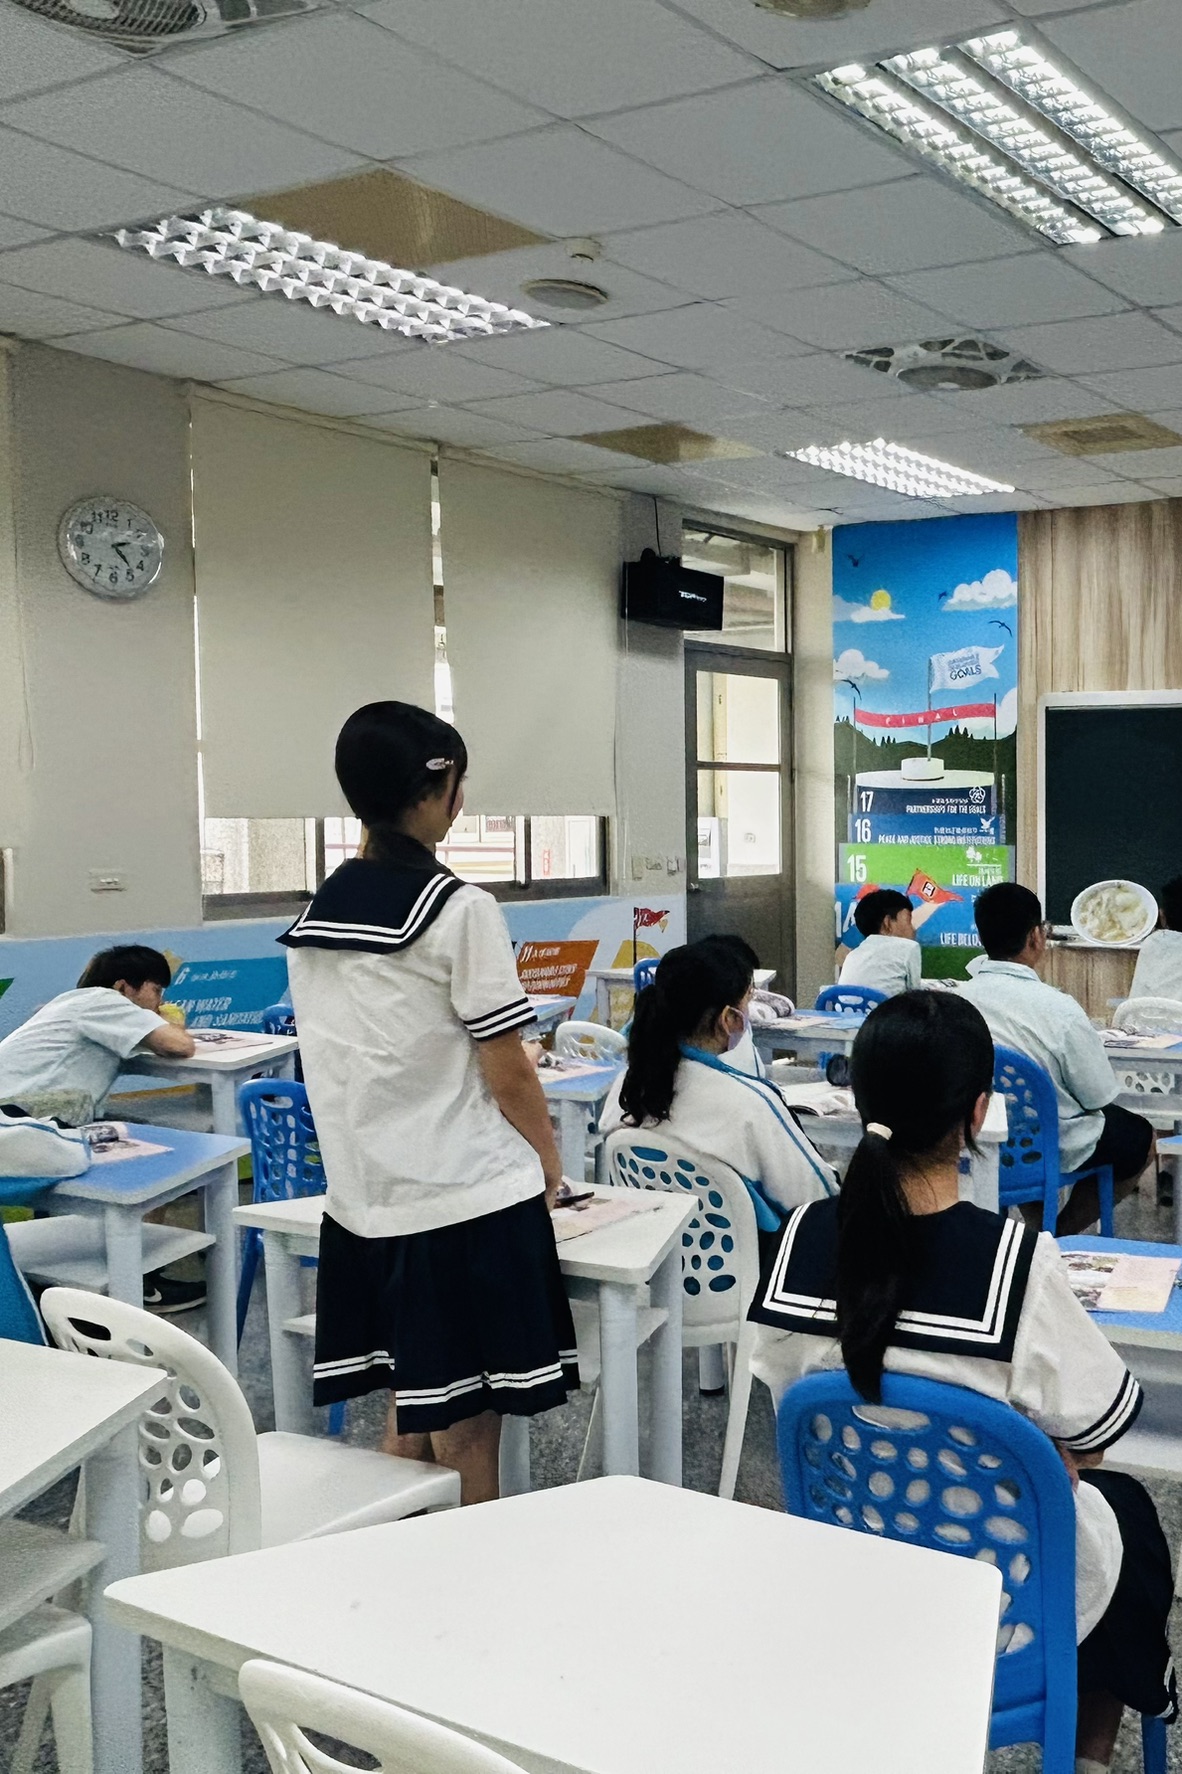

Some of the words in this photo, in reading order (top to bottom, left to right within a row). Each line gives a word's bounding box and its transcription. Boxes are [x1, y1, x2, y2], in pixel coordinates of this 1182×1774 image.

[105, 510, 119, 521] 12
[81, 552, 91, 565] 8
[94, 564, 103, 576] 7
[136, 560, 144, 571] 4
[109, 571, 118, 584] 6
[126, 568, 135, 582] 5
[950, 664, 982, 680] GOALS
[860, 791, 874, 812] 17
[855, 819, 871, 843] 16
[847, 854, 867, 882] 15
[952, 874, 968, 887] LIFE
[969, 875, 981, 887] ON
[940, 932, 957, 945] LIFE
[174, 967, 190, 985] 6
